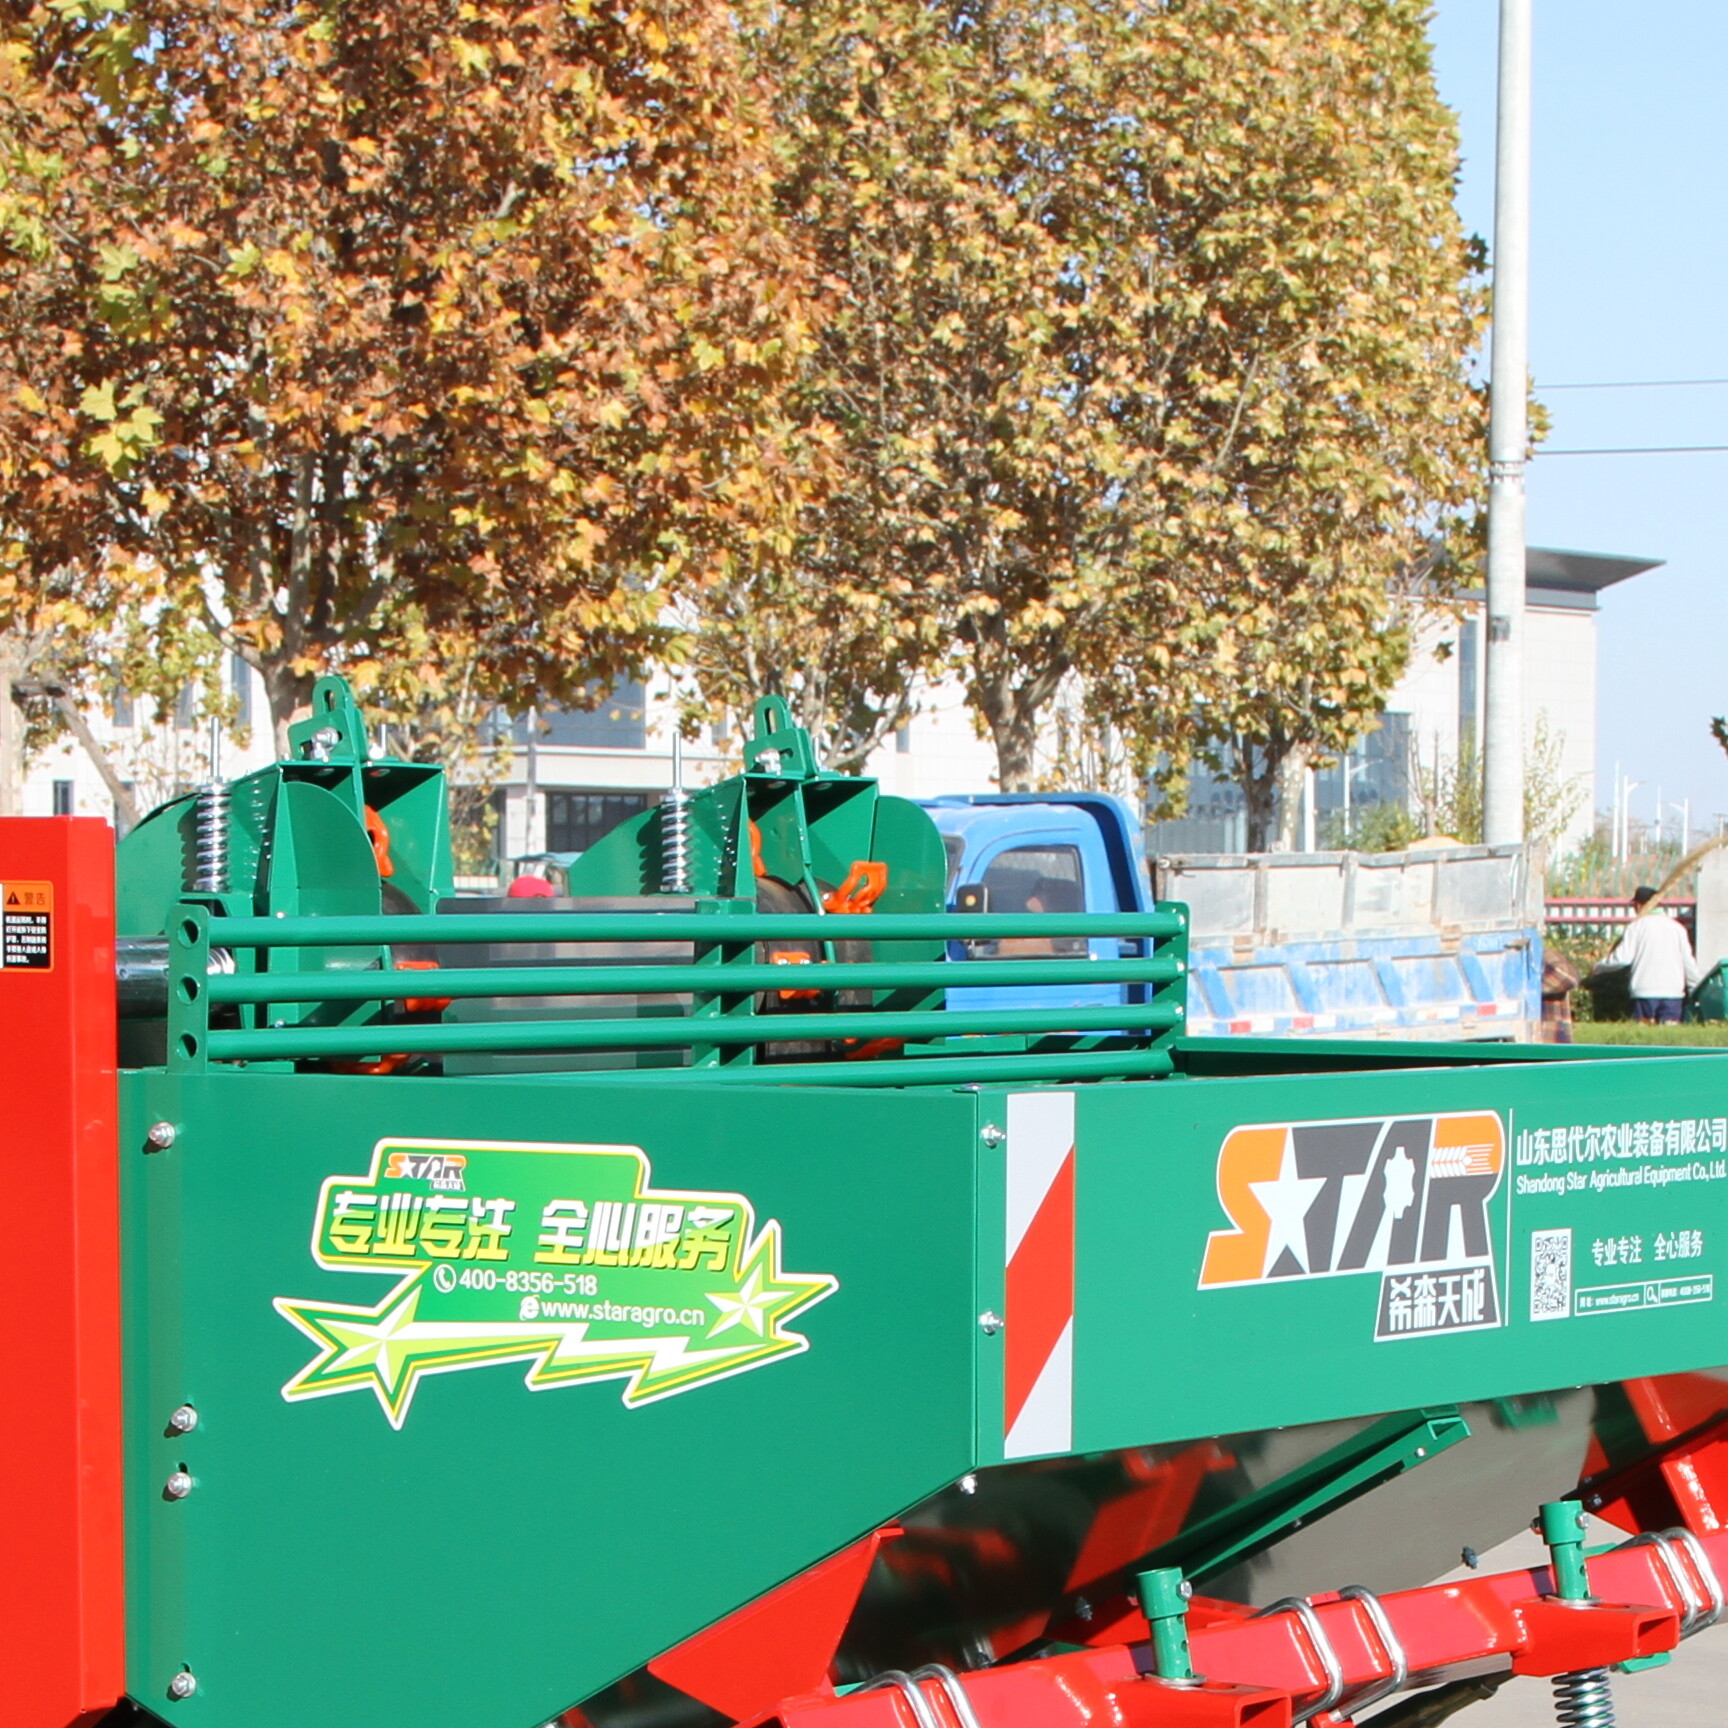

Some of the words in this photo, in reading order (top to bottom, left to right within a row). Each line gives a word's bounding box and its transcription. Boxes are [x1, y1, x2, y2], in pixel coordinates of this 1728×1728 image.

[1516, 1117, 1727, 1166] 山东思代尔农业装备有限公司
[384, 1153, 467, 1179] STAR
[1516, 1173, 1565, 1195] Shandong
[1566, 1171, 1588, 1190] Star
[1589, 1165, 1643, 1192] Agricultural
[1644, 1163, 1691, 1187] Equipment
[1198, 1111, 1505, 1290] STAR
[327, 1190, 516, 1262] 专业专注
[534, 1199, 735, 1272] 全心服务
[1592, 1235, 1642, 1267] 专业专注
[1654, 1229, 1703, 1261] 全心服务
[460, 1269, 598, 1296] 400-8356-518
[1388, 1268, 1486, 1332] 希森天成
[541, 1299, 705, 1328] www.staragro.cn
